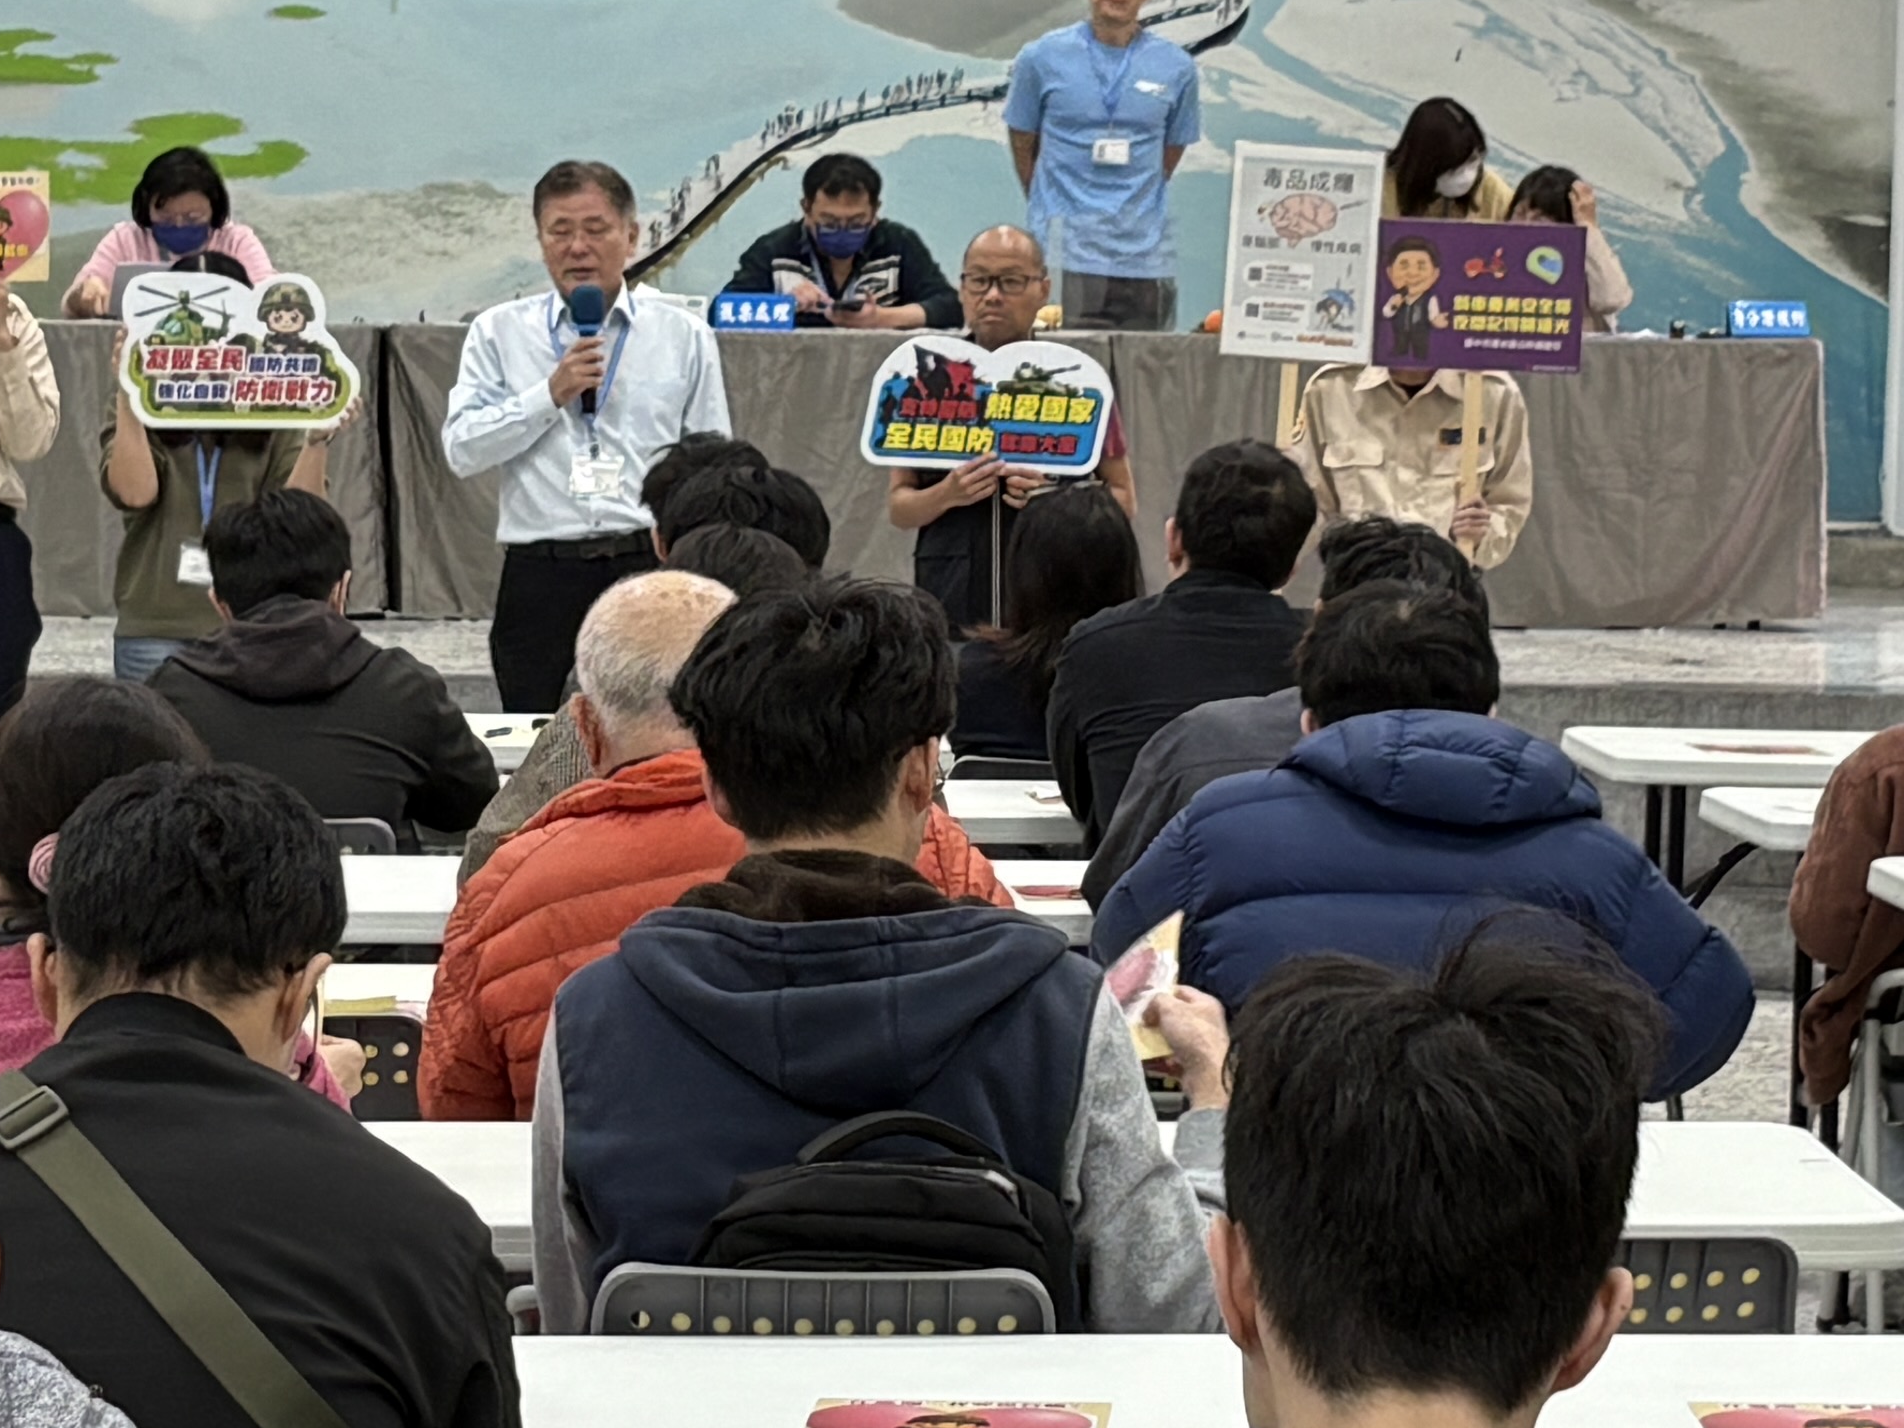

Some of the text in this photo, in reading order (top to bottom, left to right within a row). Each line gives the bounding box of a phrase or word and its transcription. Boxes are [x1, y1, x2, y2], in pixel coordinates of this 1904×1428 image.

[984, 392, 1096, 424] 熱愛國家
[882, 422, 995, 454] 全民國防
